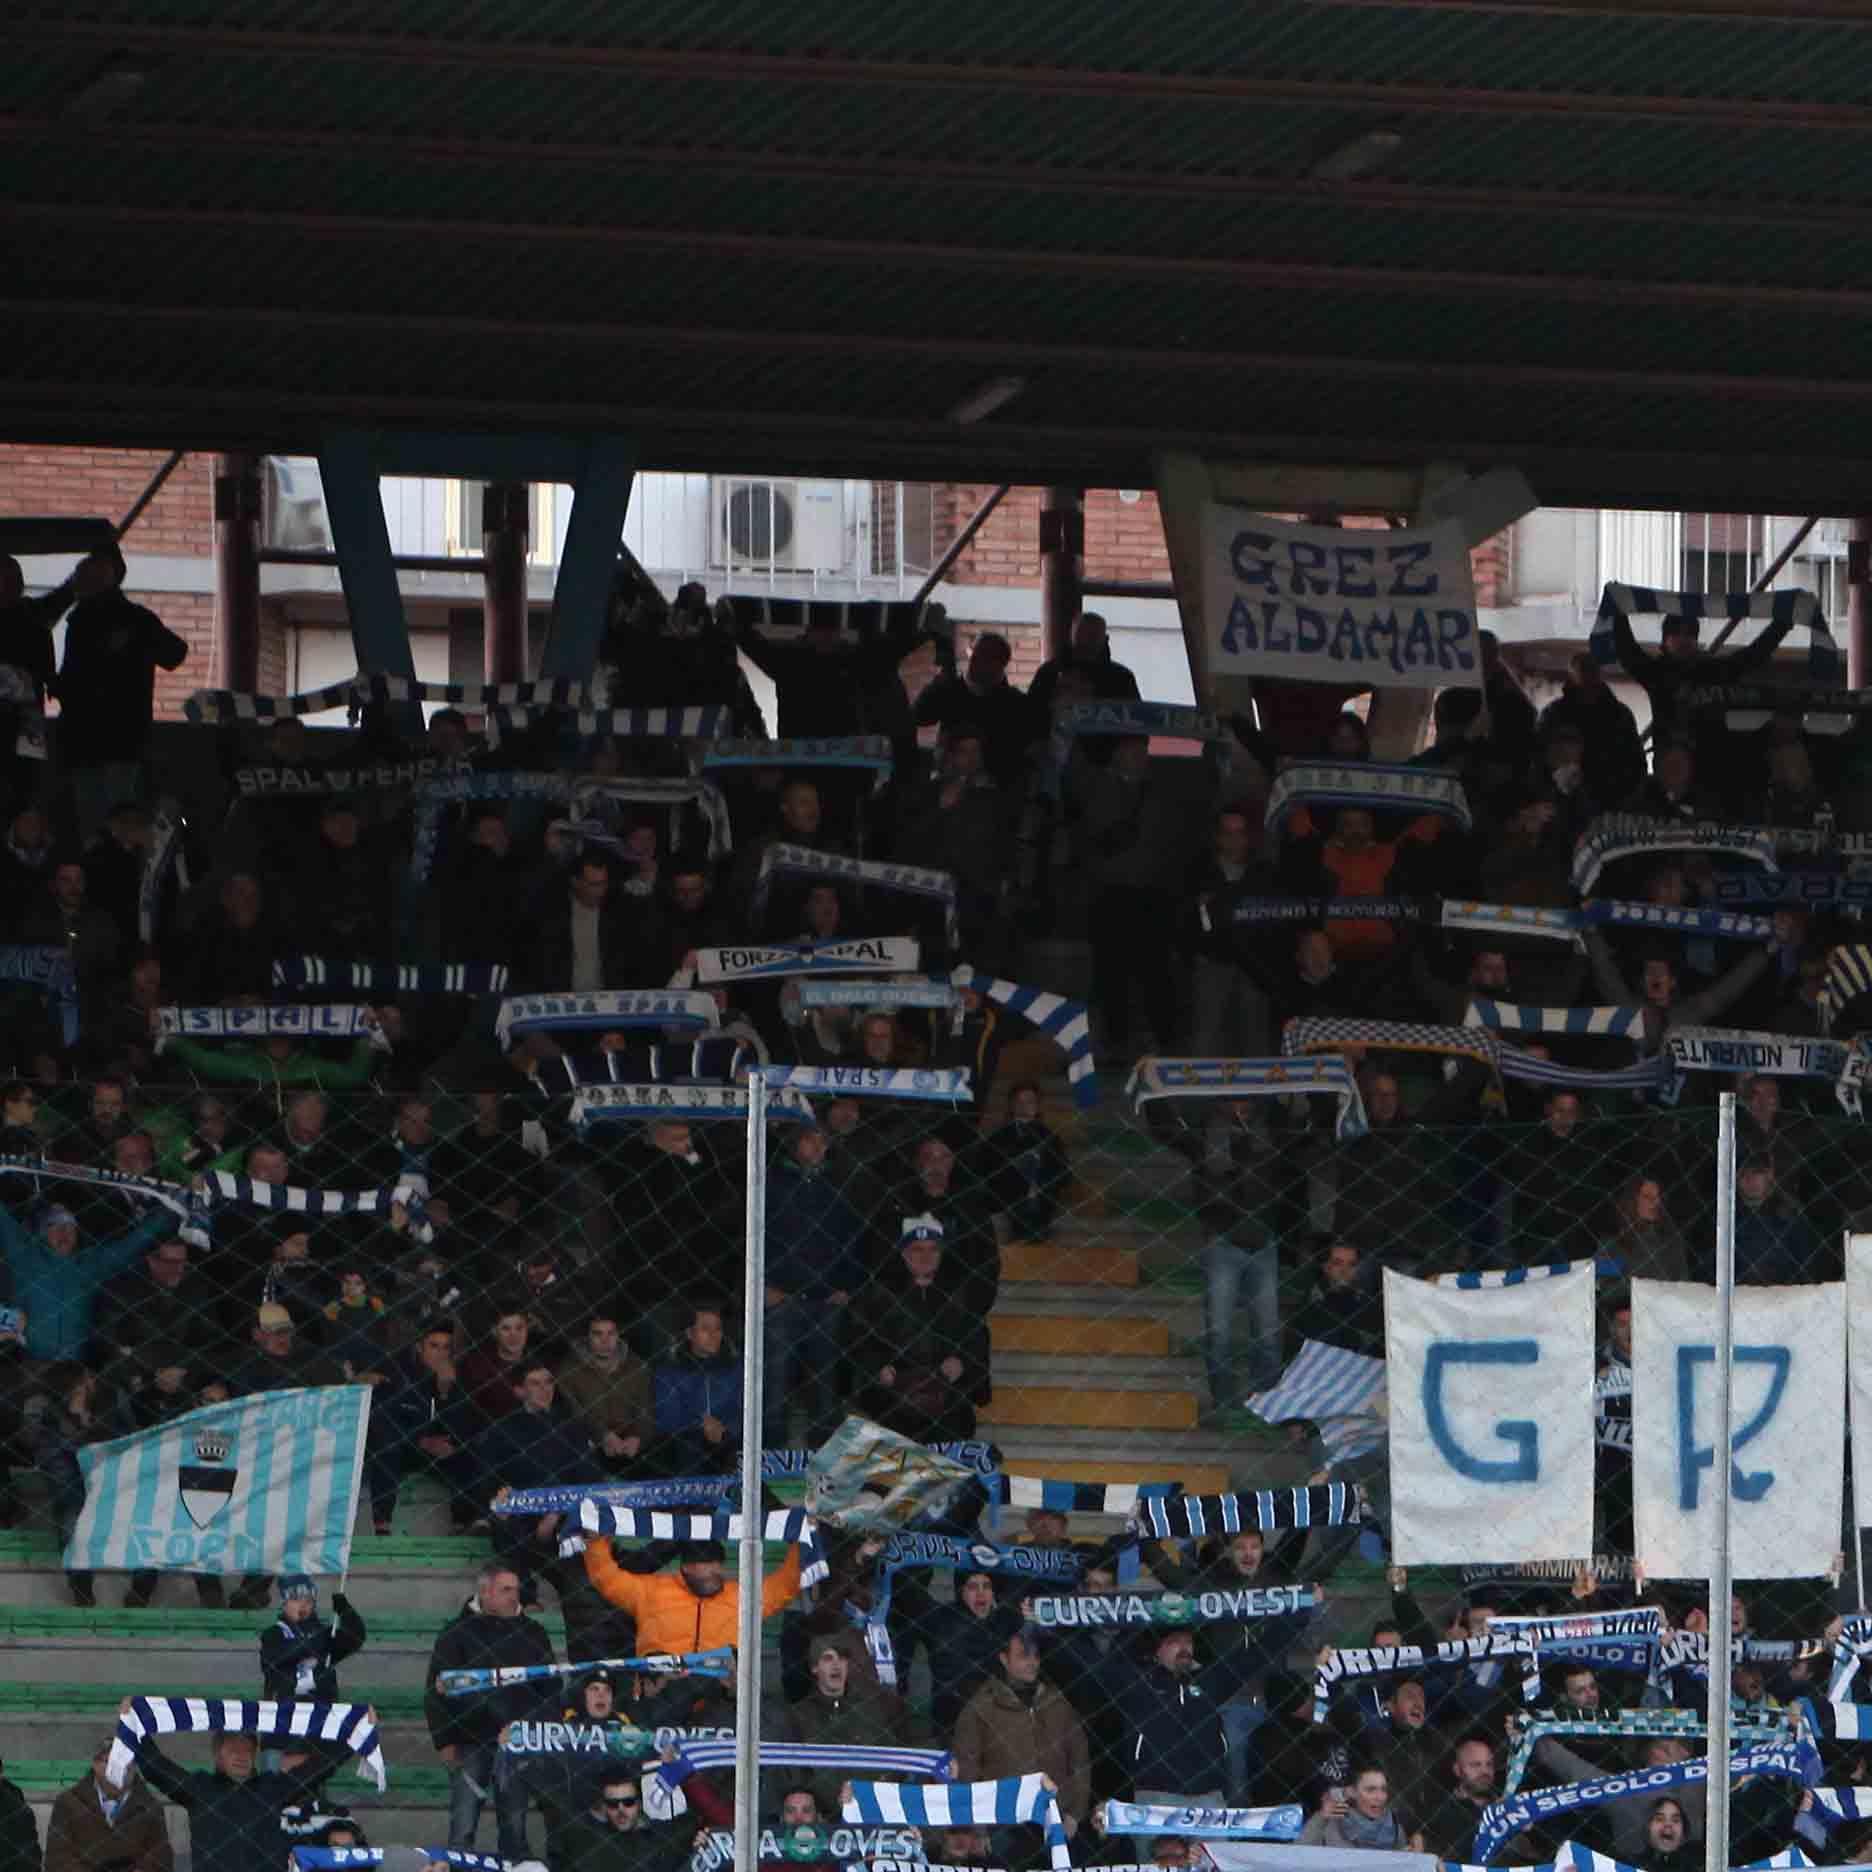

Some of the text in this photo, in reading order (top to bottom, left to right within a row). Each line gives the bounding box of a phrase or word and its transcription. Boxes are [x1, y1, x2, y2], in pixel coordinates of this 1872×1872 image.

[1230, 529, 1438, 598] GREZ
[1220, 593, 1476, 673] ALDAMAR
[1032, 1584, 1304, 1628] CURVA OVEST
[507, 1720, 607, 1753] CURVA
[1488, 1756, 1801, 1841] UN SECOLO SPAL
